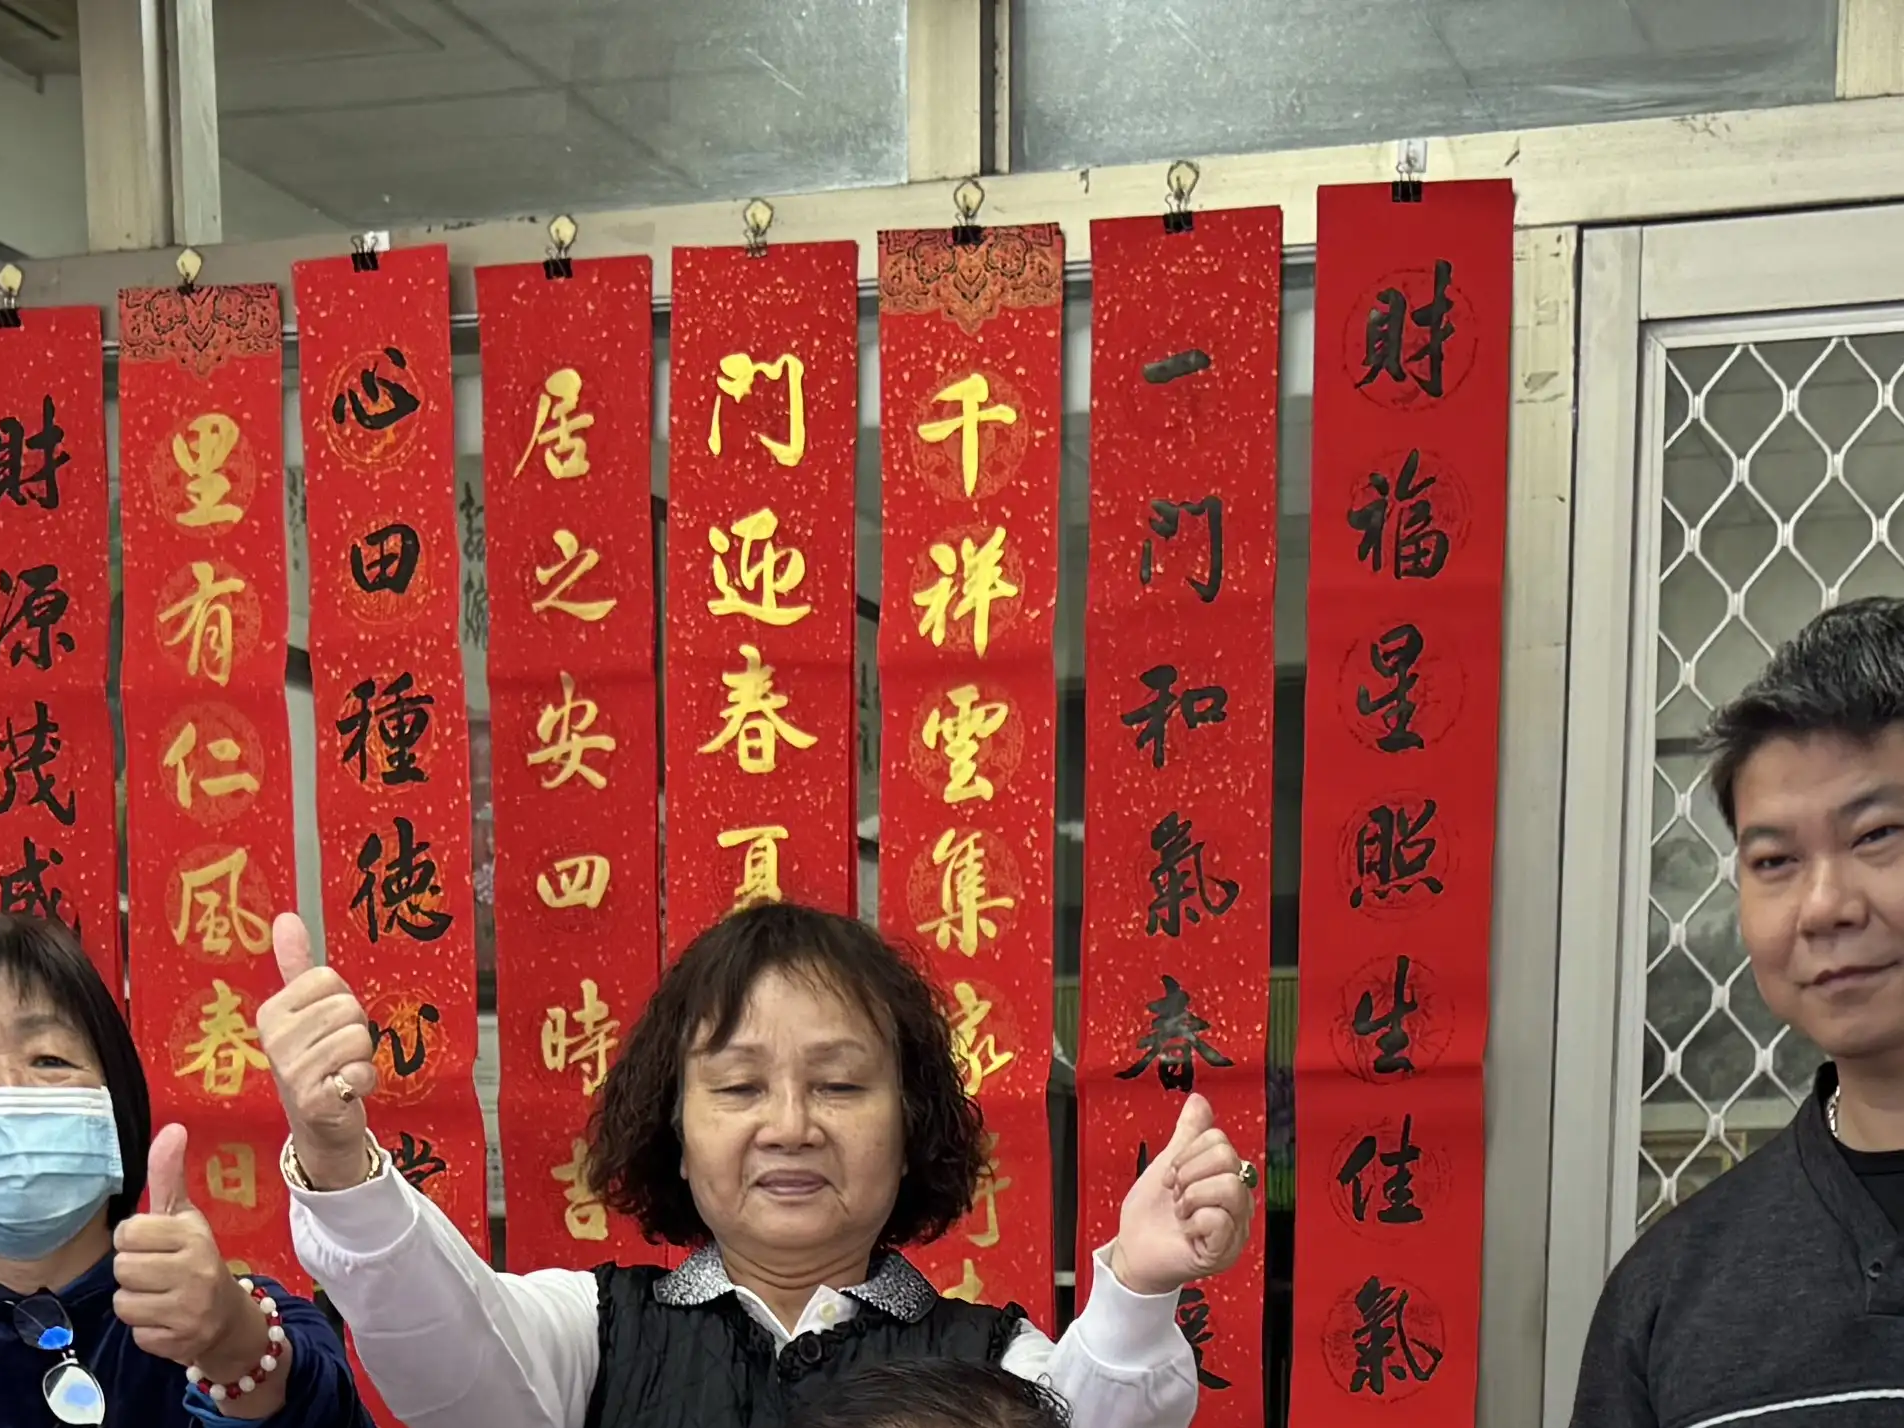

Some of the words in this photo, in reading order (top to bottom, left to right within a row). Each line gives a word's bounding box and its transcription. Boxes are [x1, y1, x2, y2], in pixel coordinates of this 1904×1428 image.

[1335, 259, 1460, 1395] 財福星照生佳氣
